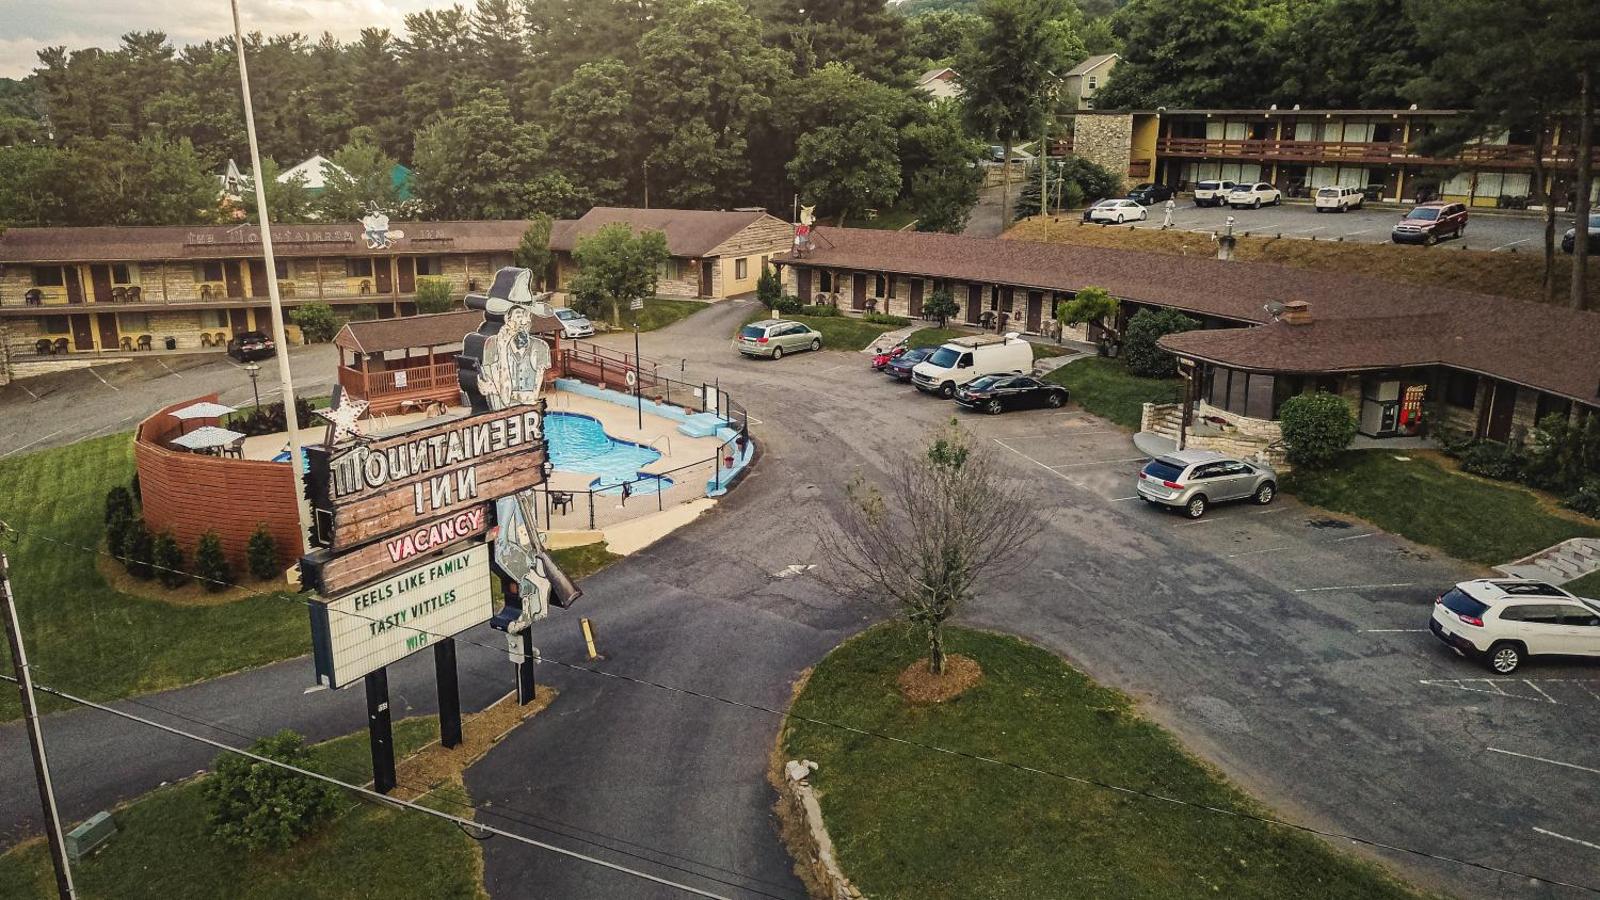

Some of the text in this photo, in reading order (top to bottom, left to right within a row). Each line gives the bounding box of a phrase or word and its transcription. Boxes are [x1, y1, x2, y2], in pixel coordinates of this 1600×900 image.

[413, 466, 477, 515] INN
[387, 508, 483, 563] VACANCY
[354, 555, 470, 611] FEELS LIKE FAMILY
[369, 589, 457, 636] TASTY VITTLES
